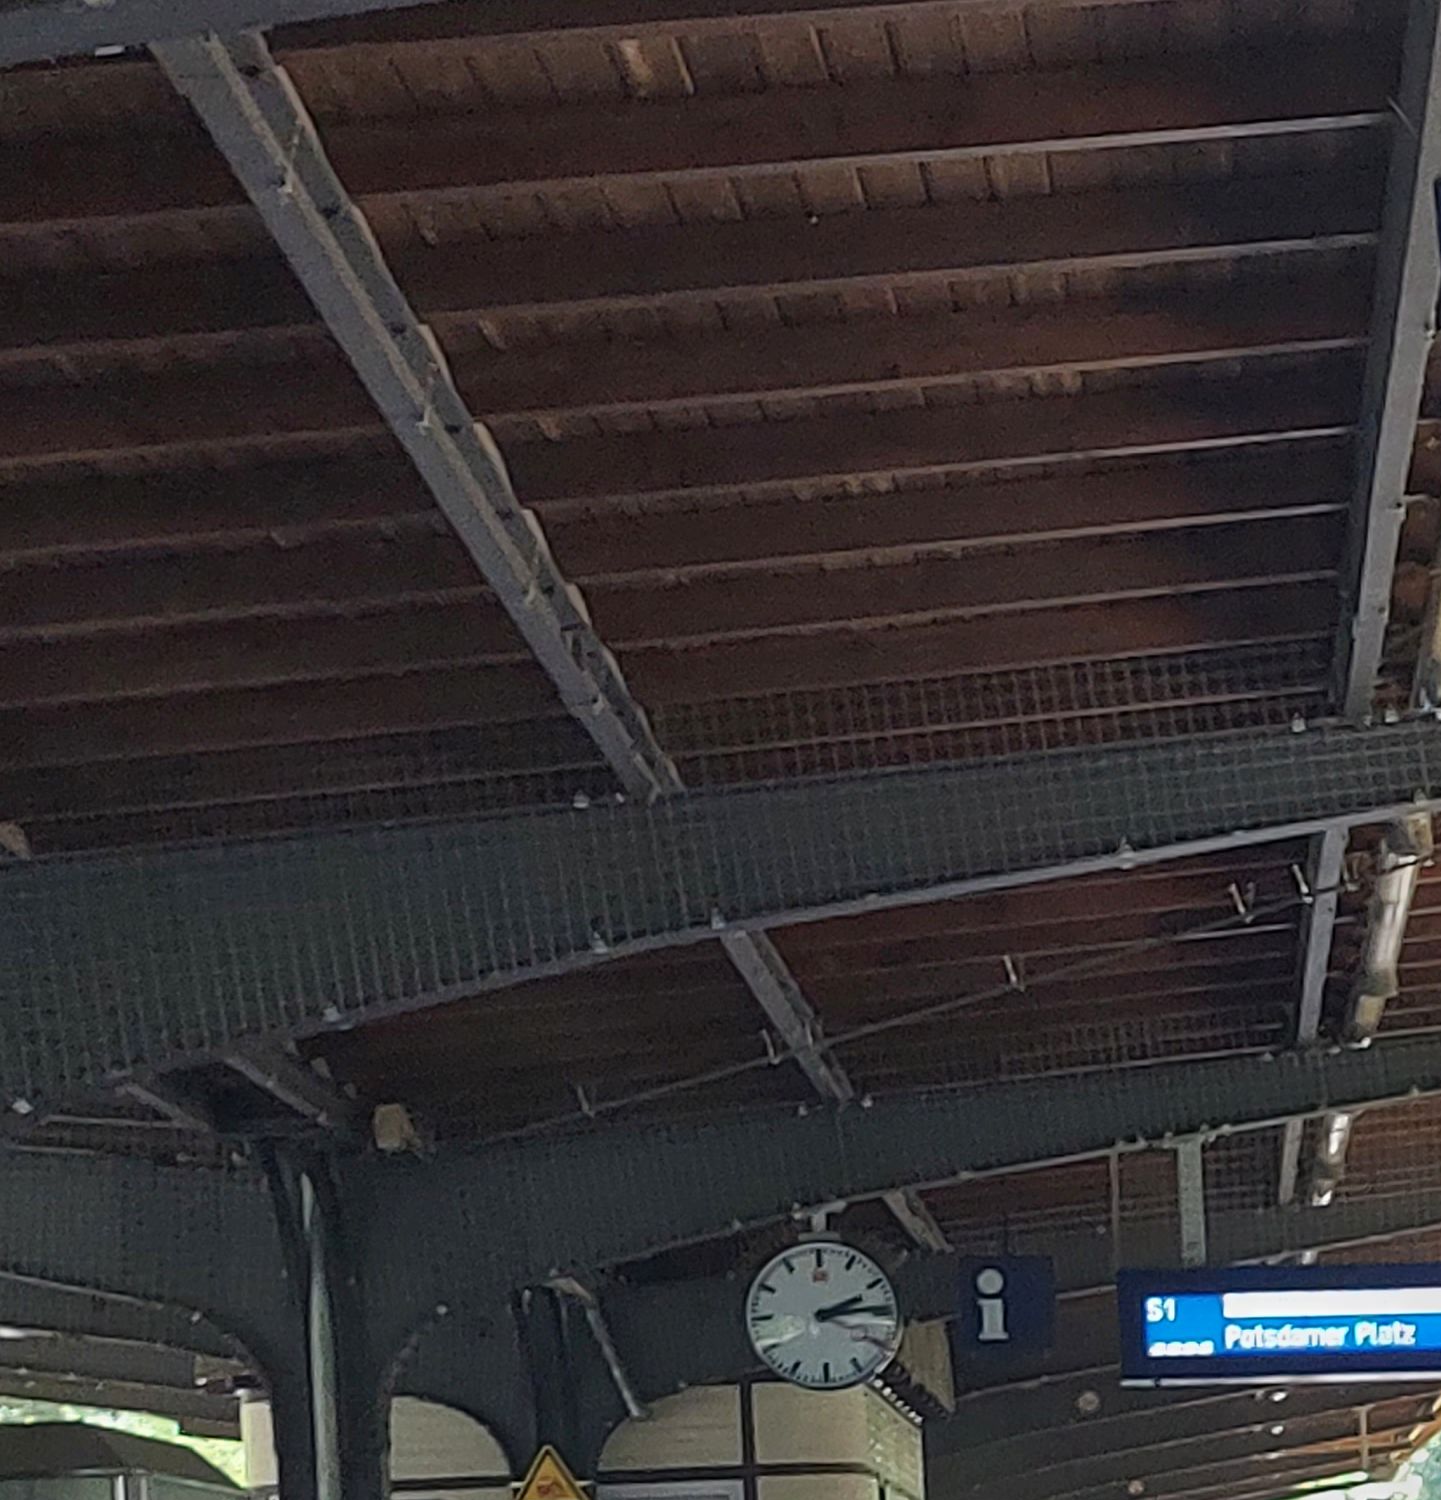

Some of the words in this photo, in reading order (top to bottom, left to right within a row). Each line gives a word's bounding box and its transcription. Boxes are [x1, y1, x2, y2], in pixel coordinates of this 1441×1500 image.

[1145, 1297, 1176, 1322] S1
[1224, 1324, 1349, 1350] Potsdamer
[1354, 1320, 1417, 1347] Platz
